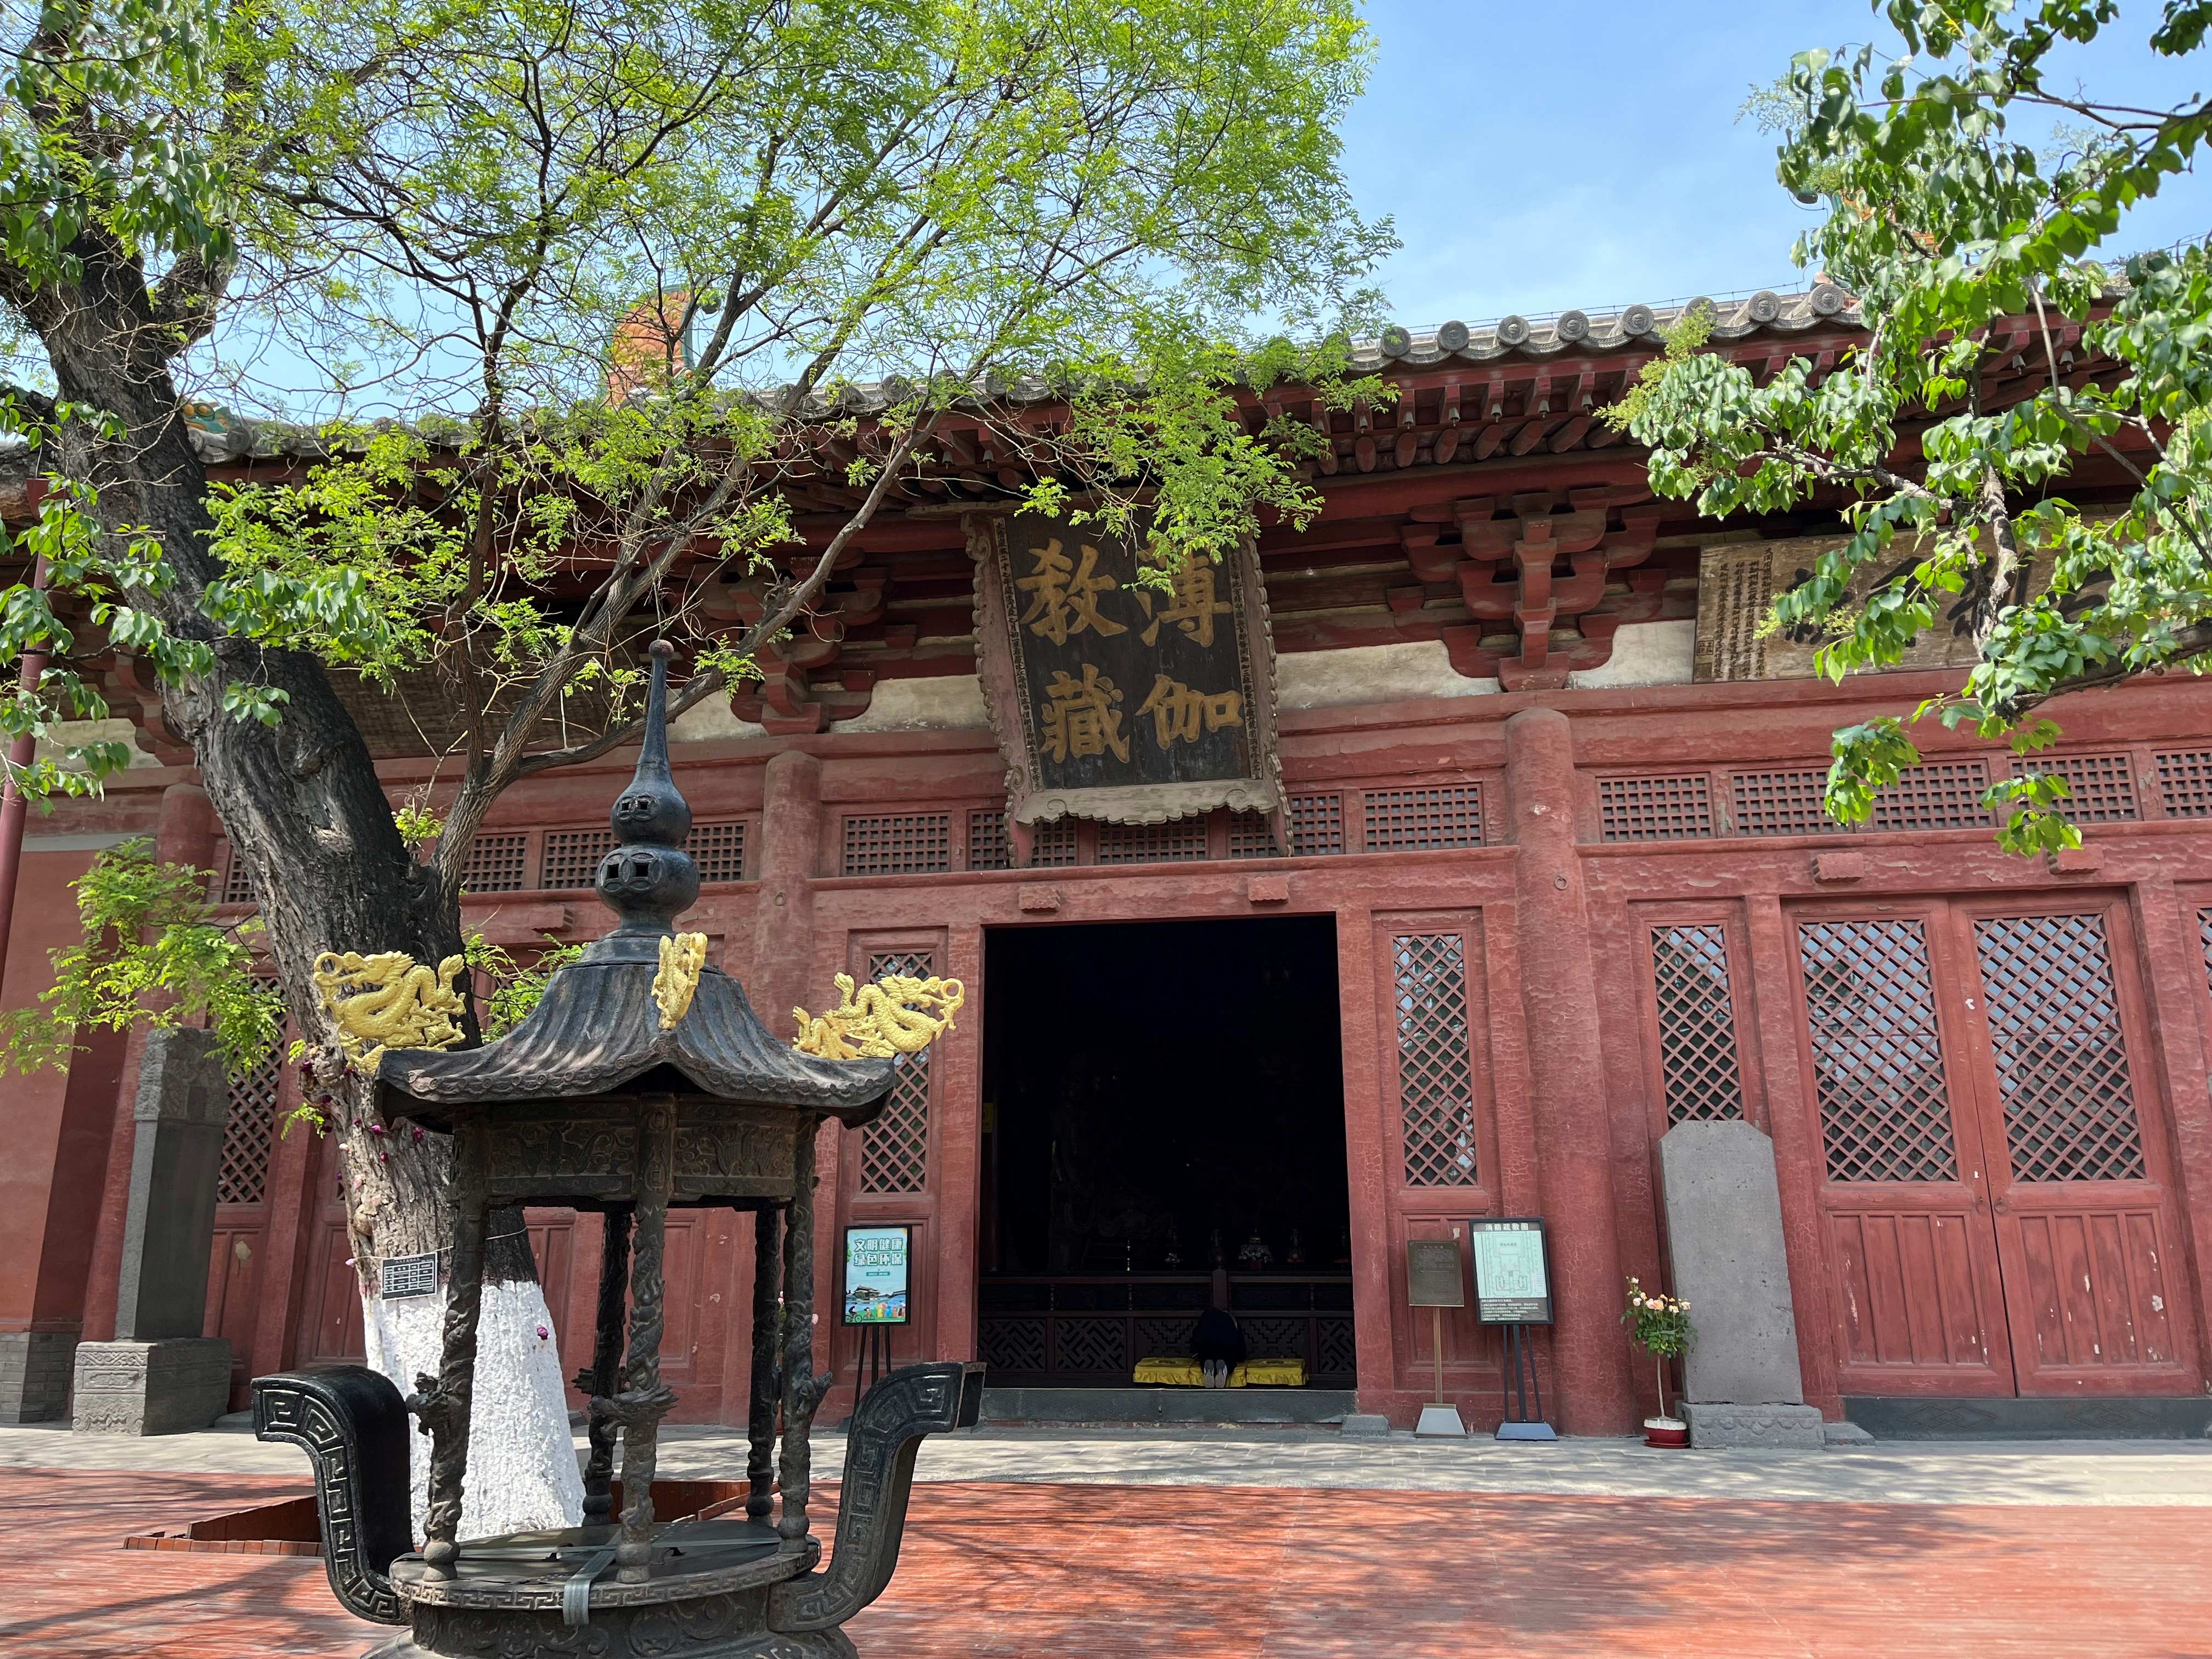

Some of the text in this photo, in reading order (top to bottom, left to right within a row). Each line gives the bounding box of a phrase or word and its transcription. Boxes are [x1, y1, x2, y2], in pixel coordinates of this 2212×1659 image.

[854, 1238, 903, 1252] 文明健康
[854, 1252, 903, 1266] 绿色环保
